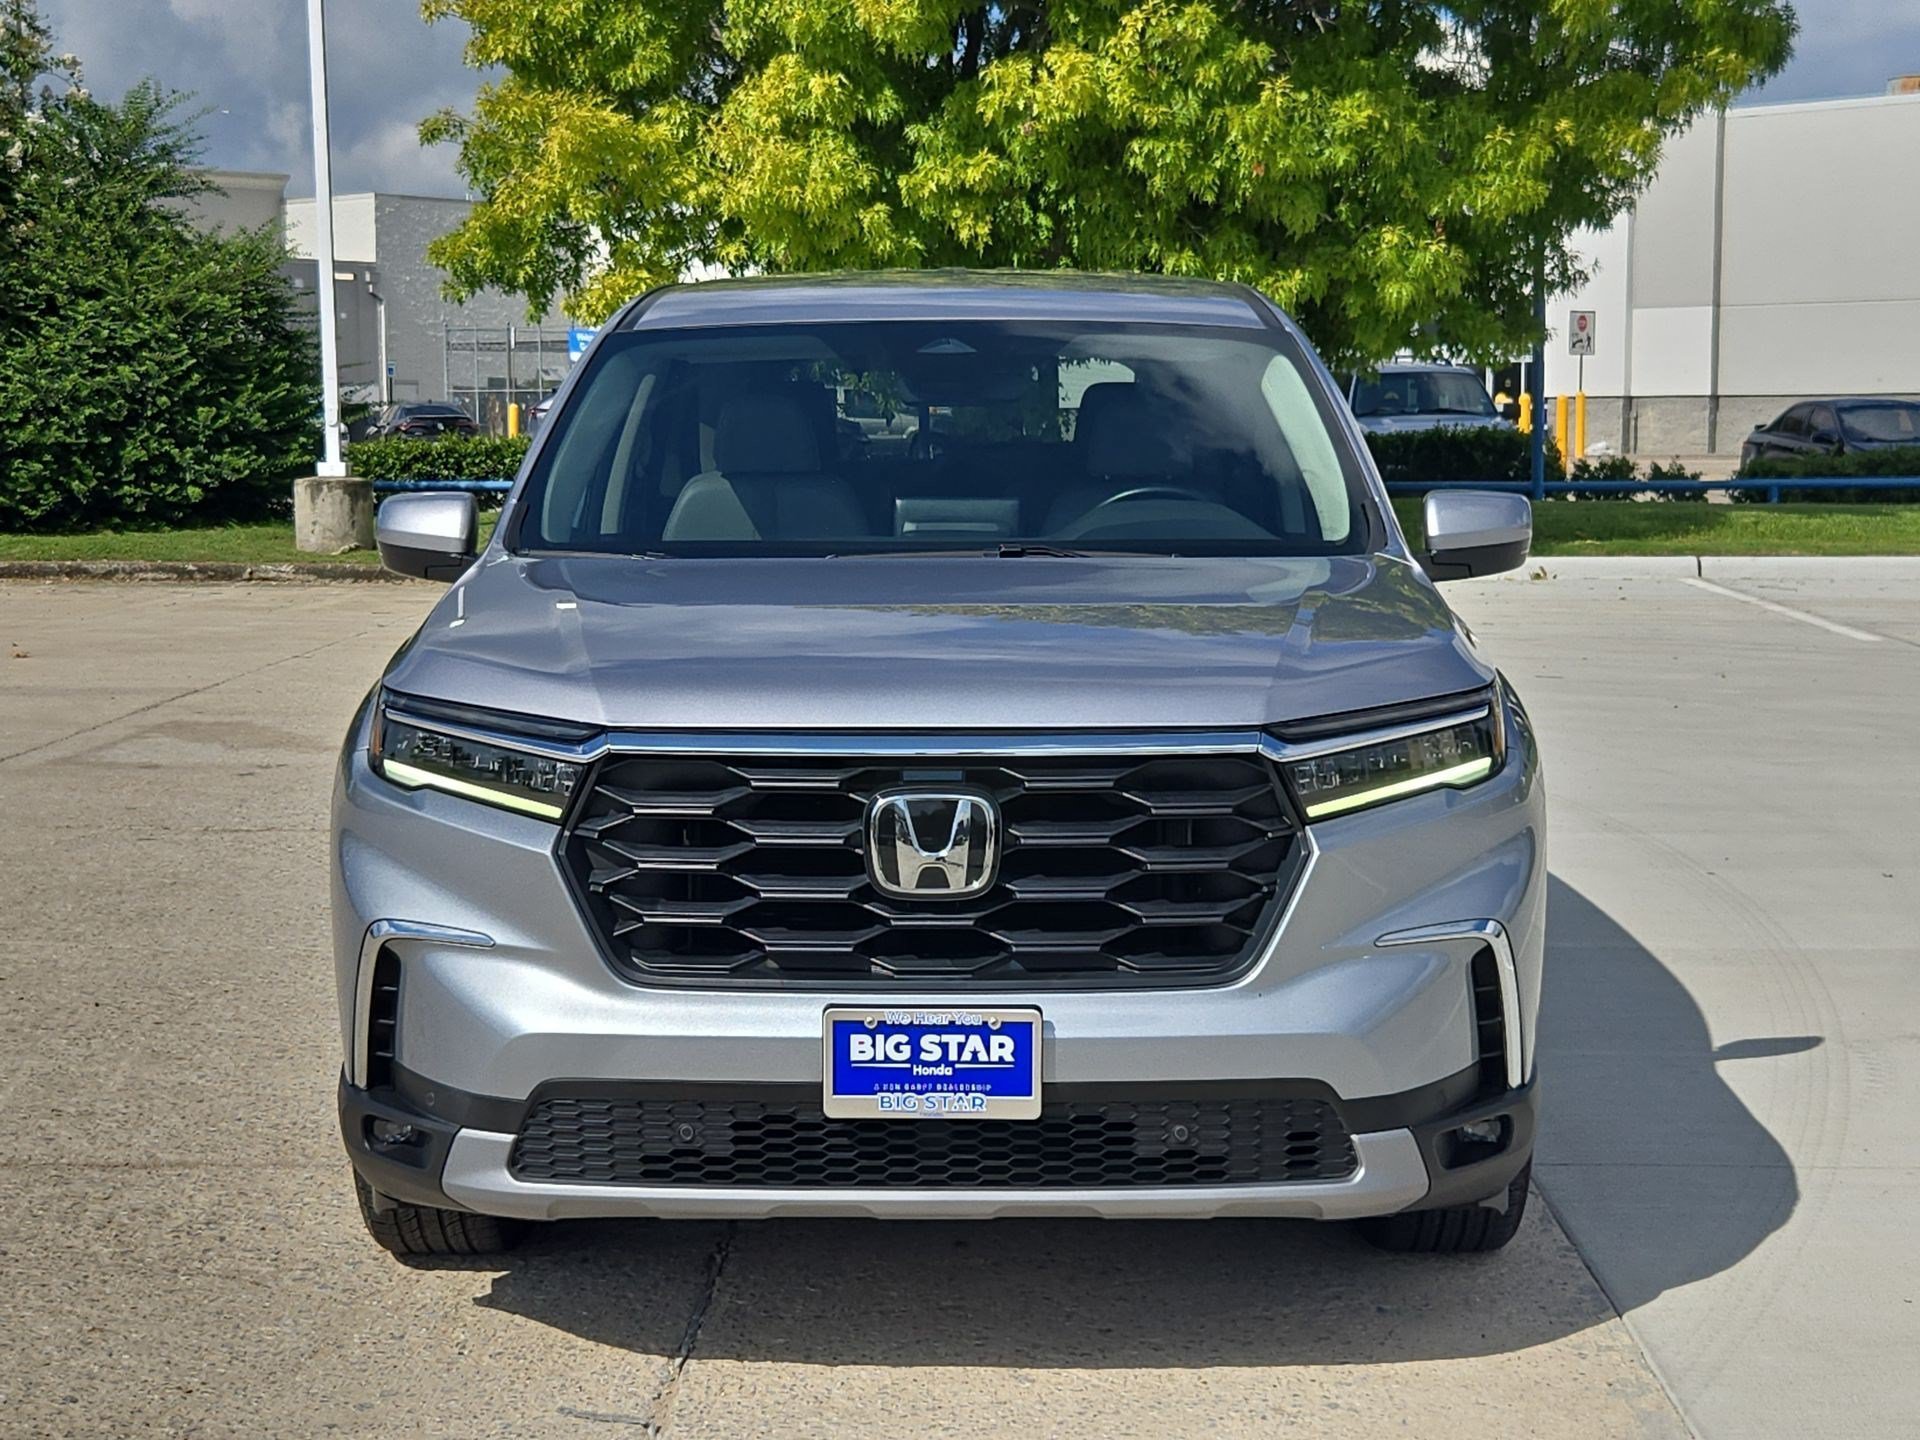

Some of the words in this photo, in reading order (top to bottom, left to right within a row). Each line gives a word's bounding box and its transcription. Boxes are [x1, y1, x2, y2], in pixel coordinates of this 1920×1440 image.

[884, 1010, 911, 1025] We
[913, 1011, 950, 1025] Hear
[952, 1011, 983, 1026] You
[850, 1034, 911, 1061] BIG
[919, 1034, 1015, 1062] STAR
[912, 1064, 953, 1076] Honda
[879, 1093, 917, 1110] BIG
[924, 1093, 986, 1111] STAR
